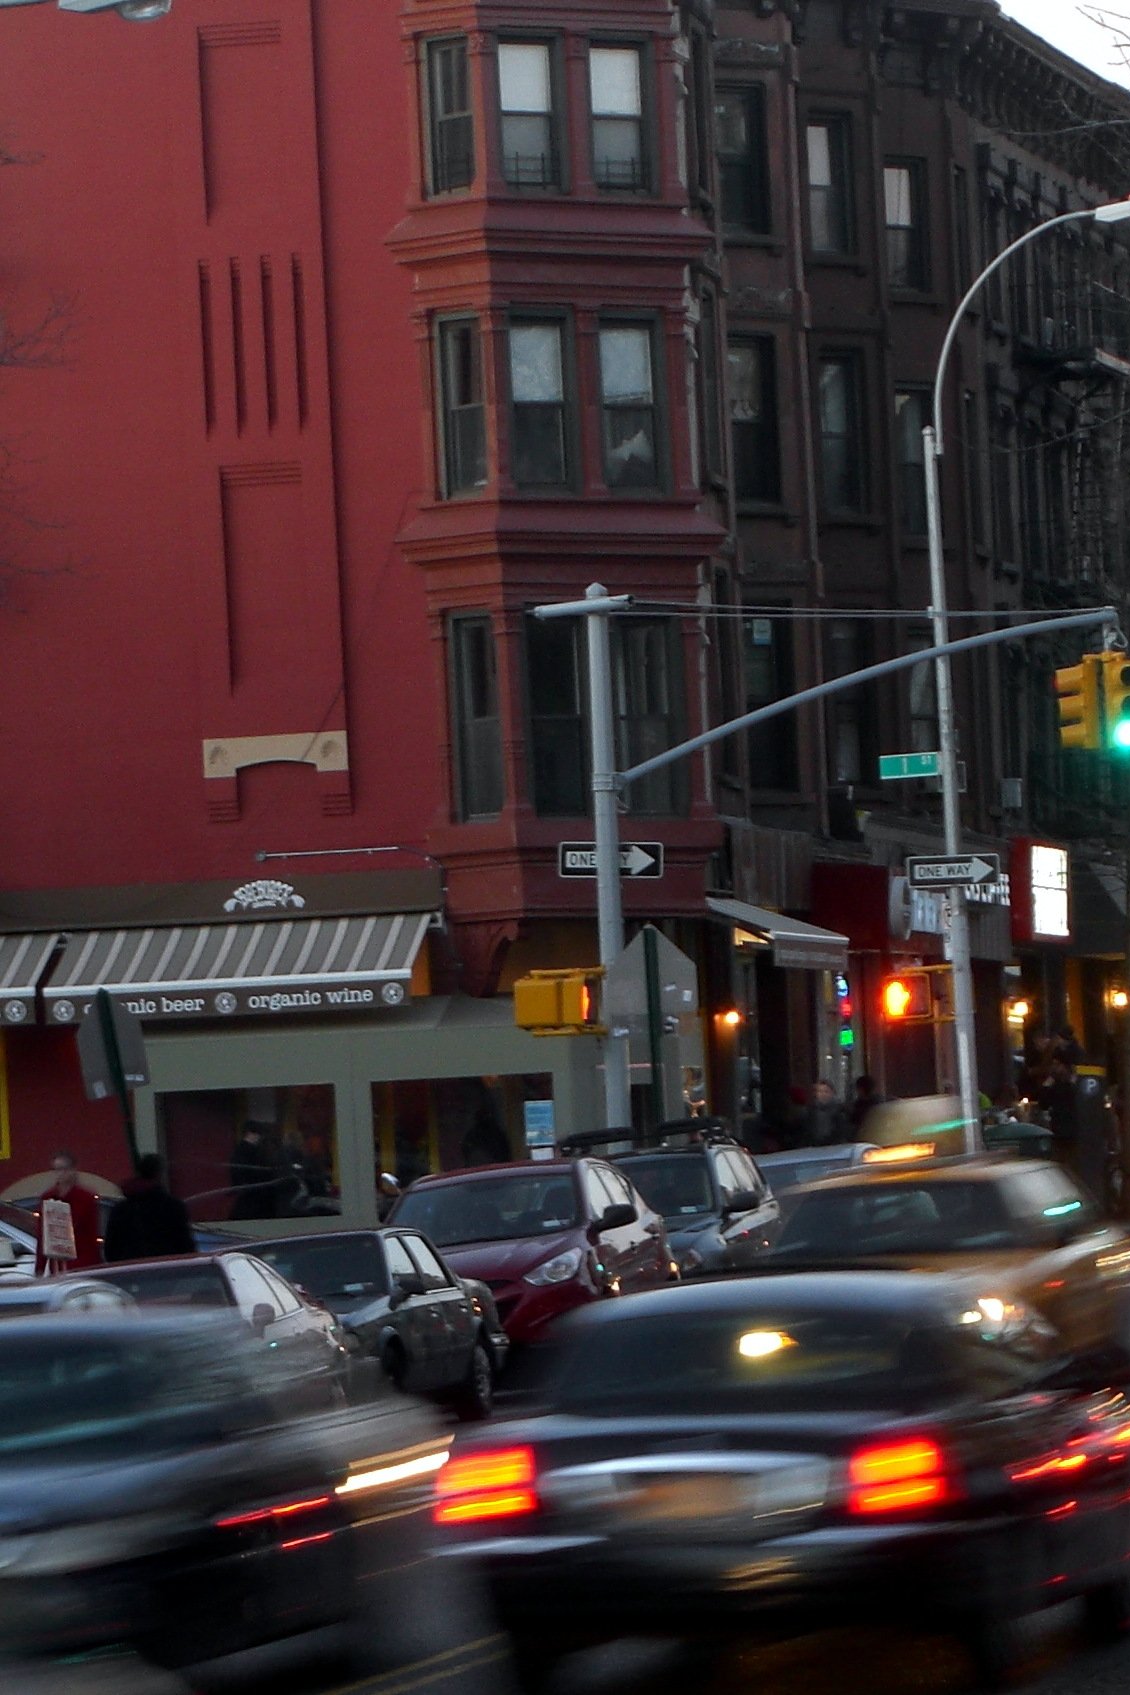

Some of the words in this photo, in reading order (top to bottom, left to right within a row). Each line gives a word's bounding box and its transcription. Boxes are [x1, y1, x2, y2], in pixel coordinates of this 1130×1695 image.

[569, 852, 596, 867] ONE
[918, 866, 942, 878] ONE
[946, 863, 971, 876] WAY
[161, 997, 205, 1013] beer
[248, 990, 322, 1011] organic
[325, 988, 374, 1004] wine
